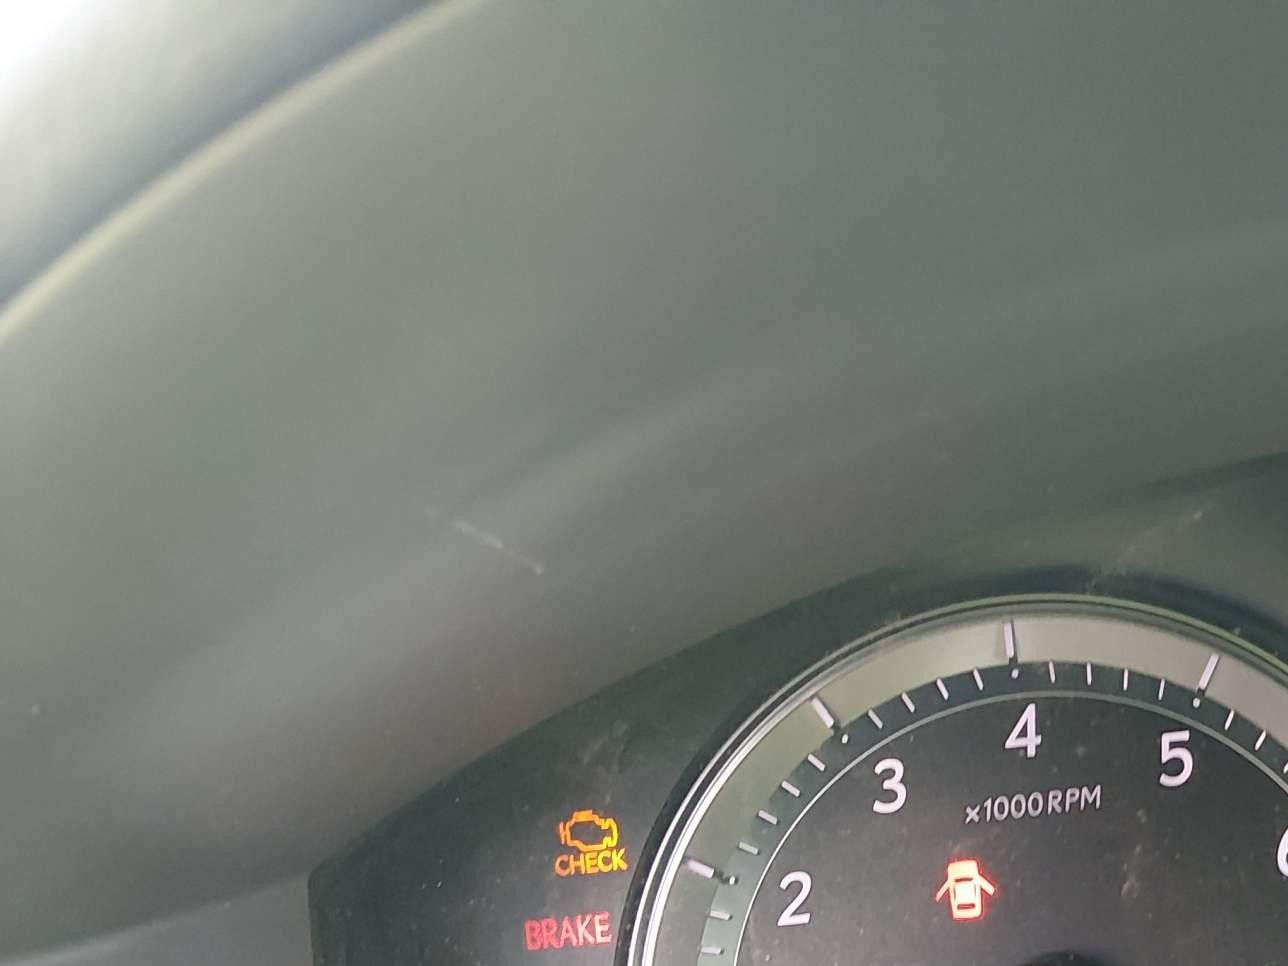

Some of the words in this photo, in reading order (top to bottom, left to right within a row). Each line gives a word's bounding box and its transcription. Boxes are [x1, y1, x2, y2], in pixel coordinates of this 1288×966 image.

[1004, 703, 1042, 757] 4
[1159, 730, 1194, 787] 5
[872, 759, 907, 814] 3
[554, 849, 628, 875] CHECK
[777, 871, 811, 926] 2
[525, 913, 613, 950] BRAKE
